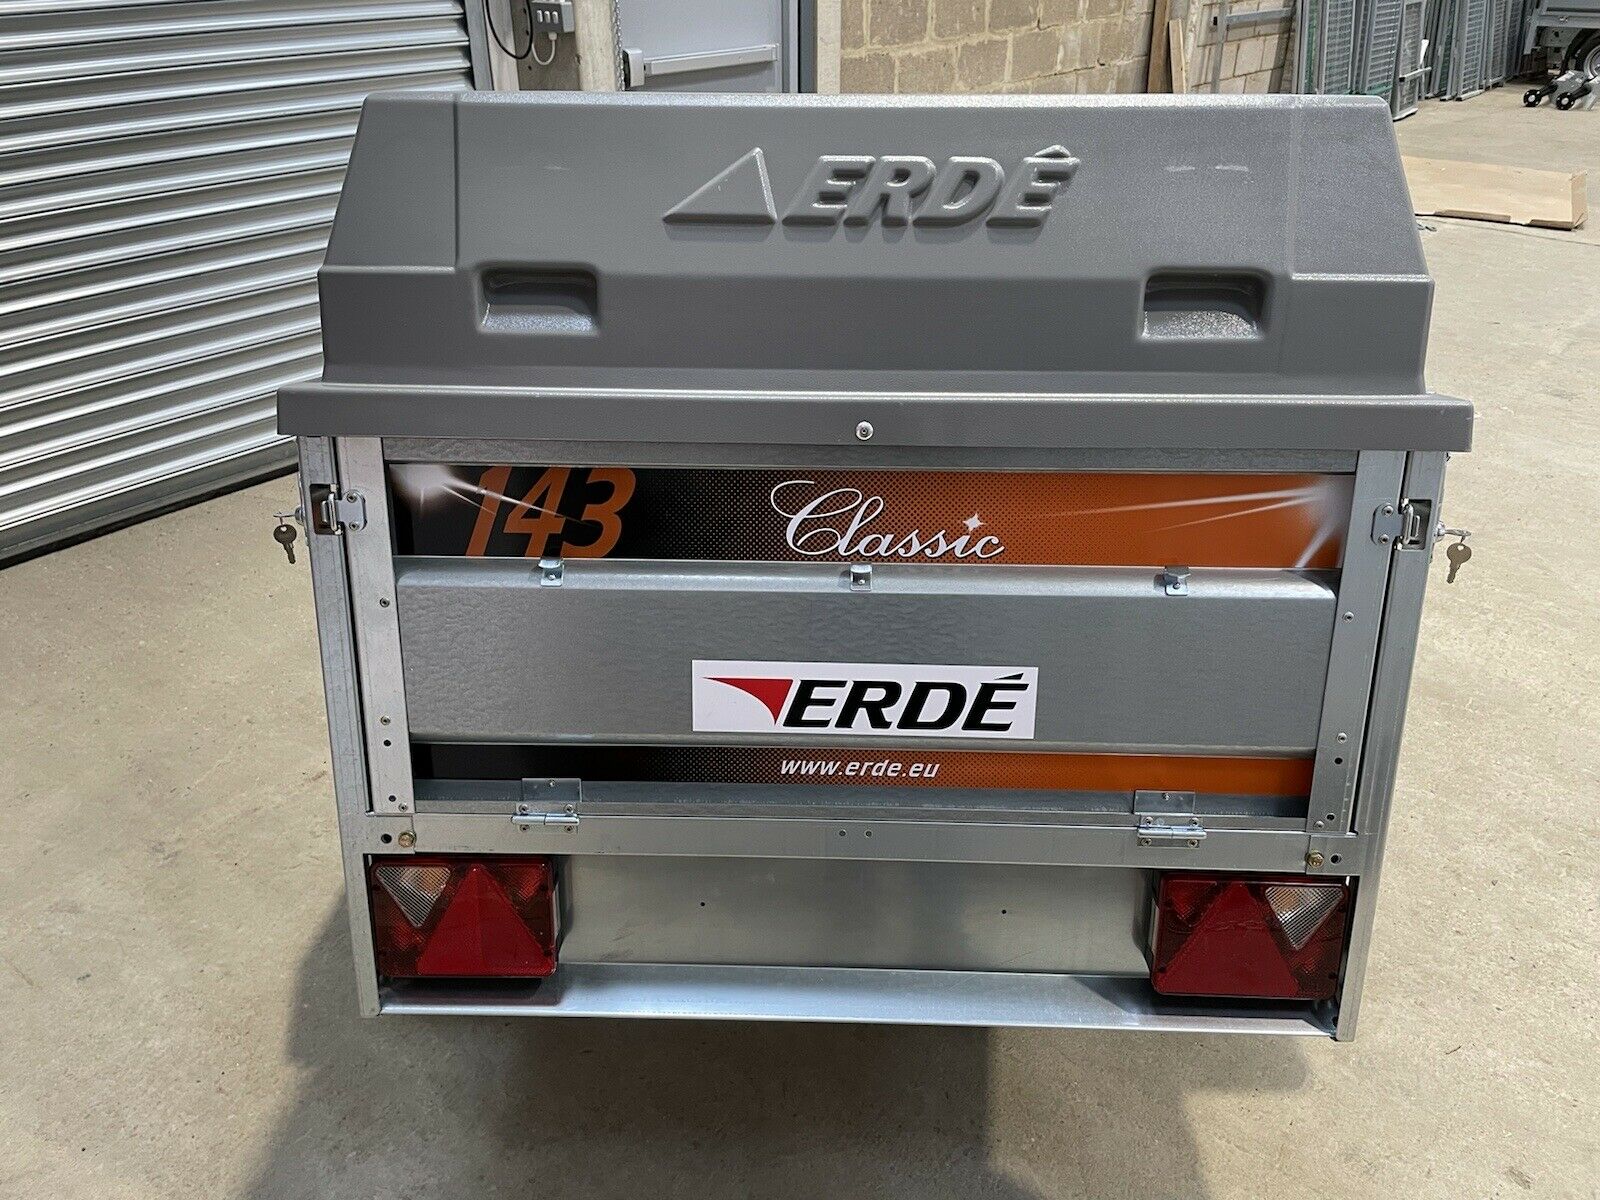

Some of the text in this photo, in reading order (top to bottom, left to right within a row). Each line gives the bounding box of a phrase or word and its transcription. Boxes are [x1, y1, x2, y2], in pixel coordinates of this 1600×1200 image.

[782, 144, 1081, 228] ERDÉ
[465, 466, 637, 558] 143
[770, 480, 1005, 559] Classic
[782, 672, 1029, 732] ERDÉ
[780, 758, 940, 779] www.erde.eu
